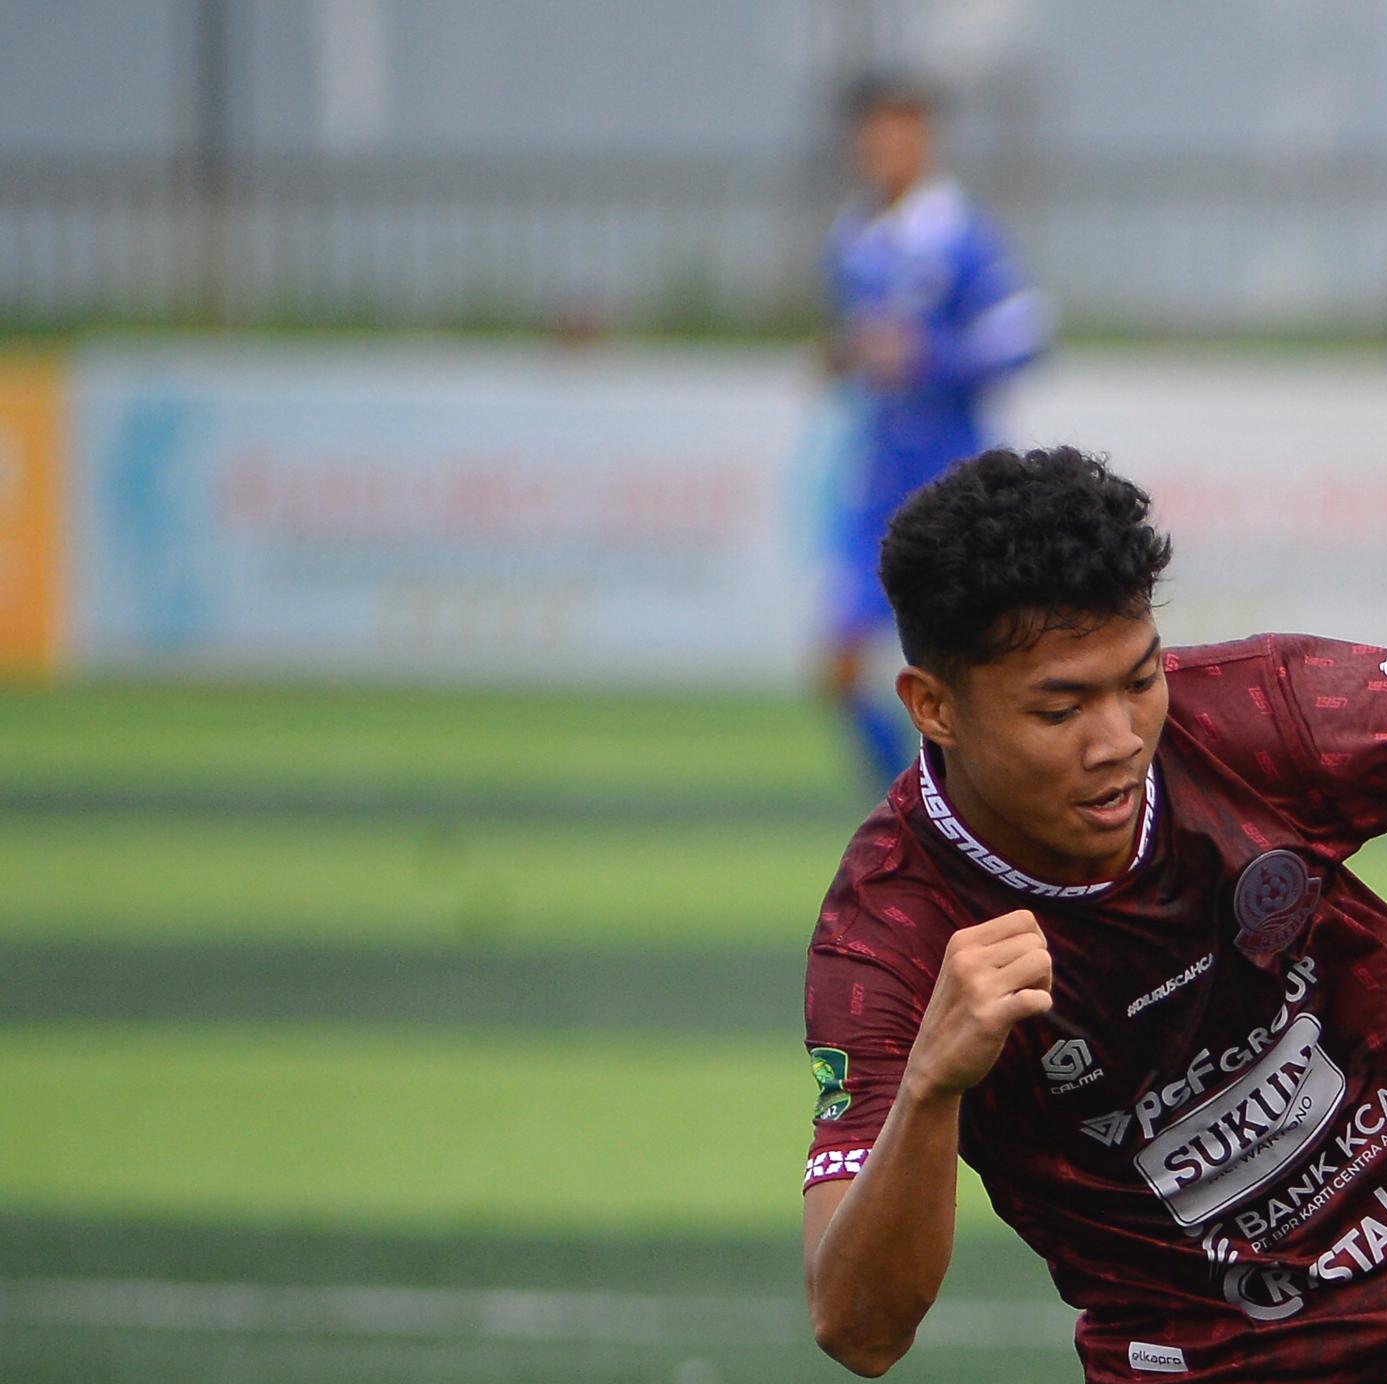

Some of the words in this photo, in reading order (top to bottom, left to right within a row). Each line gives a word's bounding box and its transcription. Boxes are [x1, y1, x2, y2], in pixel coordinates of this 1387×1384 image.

[1050, 1068, 1104, 1095] CALMA
[1235, 1151, 1339, 1239] BANK
[1300, 1185, 1336, 1221] KARTI
[1333, 1143, 1383, 1190] CENTRA
